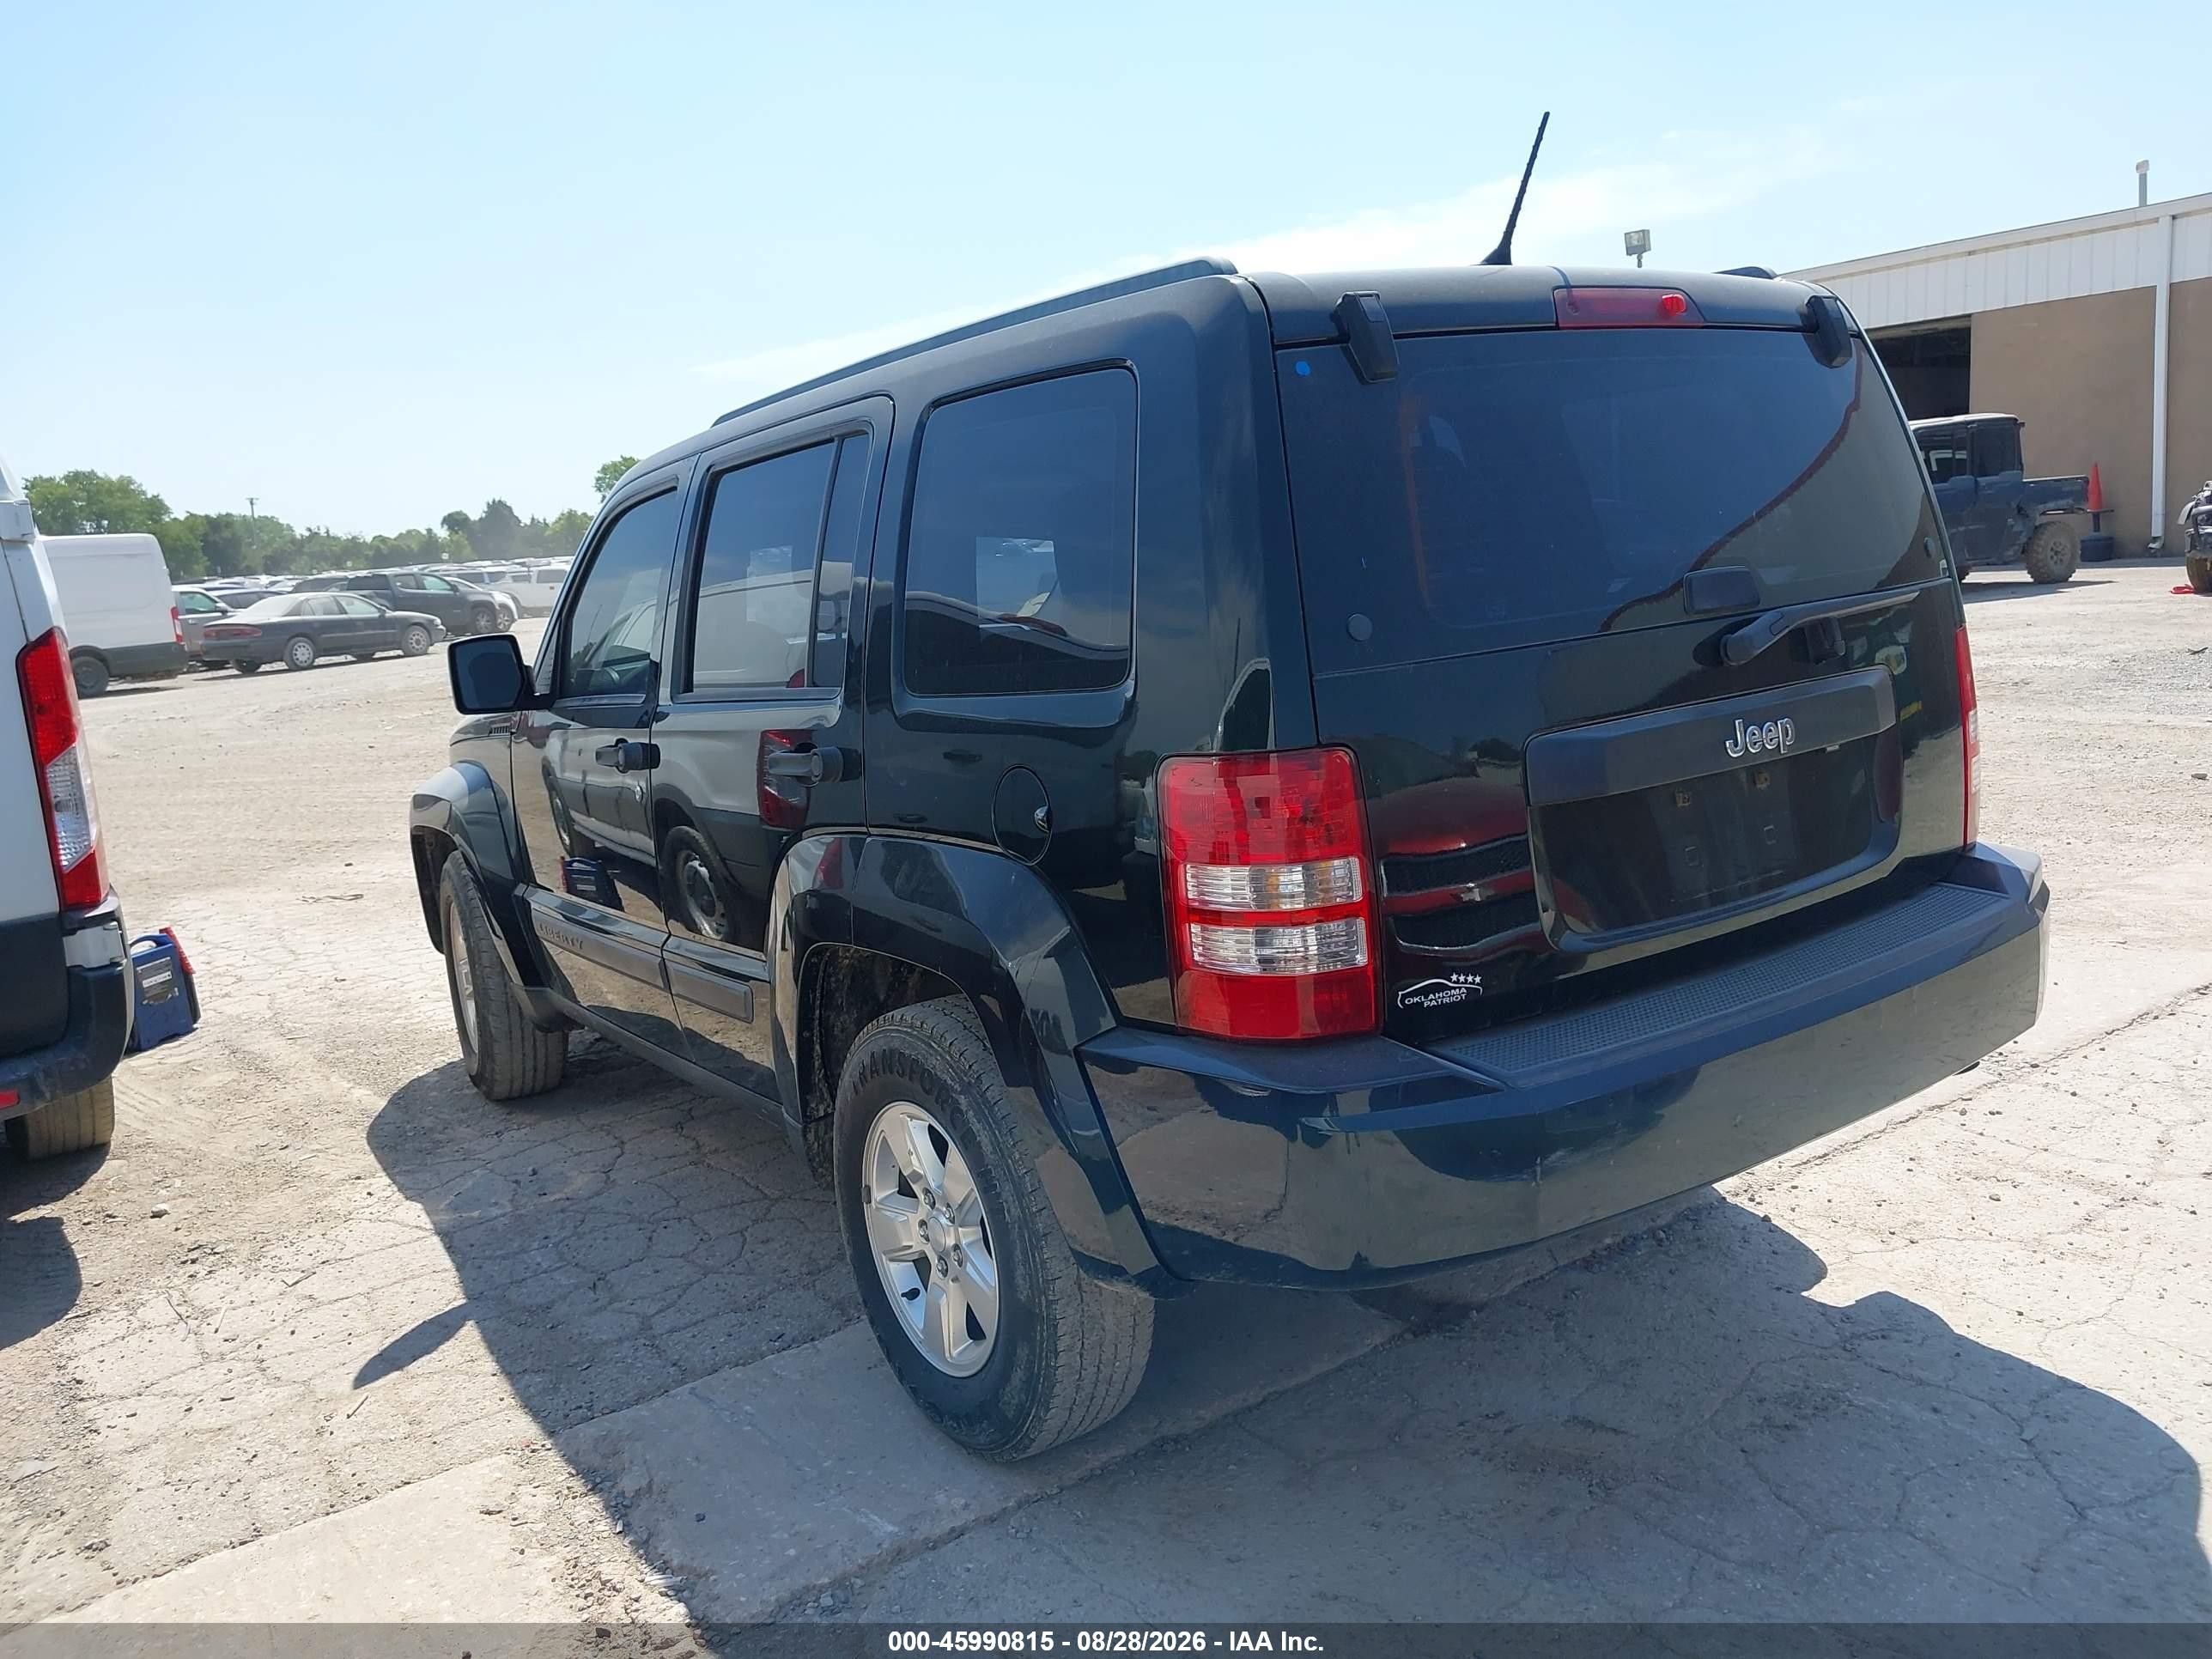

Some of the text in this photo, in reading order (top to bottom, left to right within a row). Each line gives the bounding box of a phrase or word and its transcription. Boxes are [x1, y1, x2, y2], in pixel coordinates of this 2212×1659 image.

[1725, 718, 1796, 757] Jeep
[1405, 988, 1467, 1005] OKLAHOMA
[1424, 994, 1467, 1007] PATRIOT
